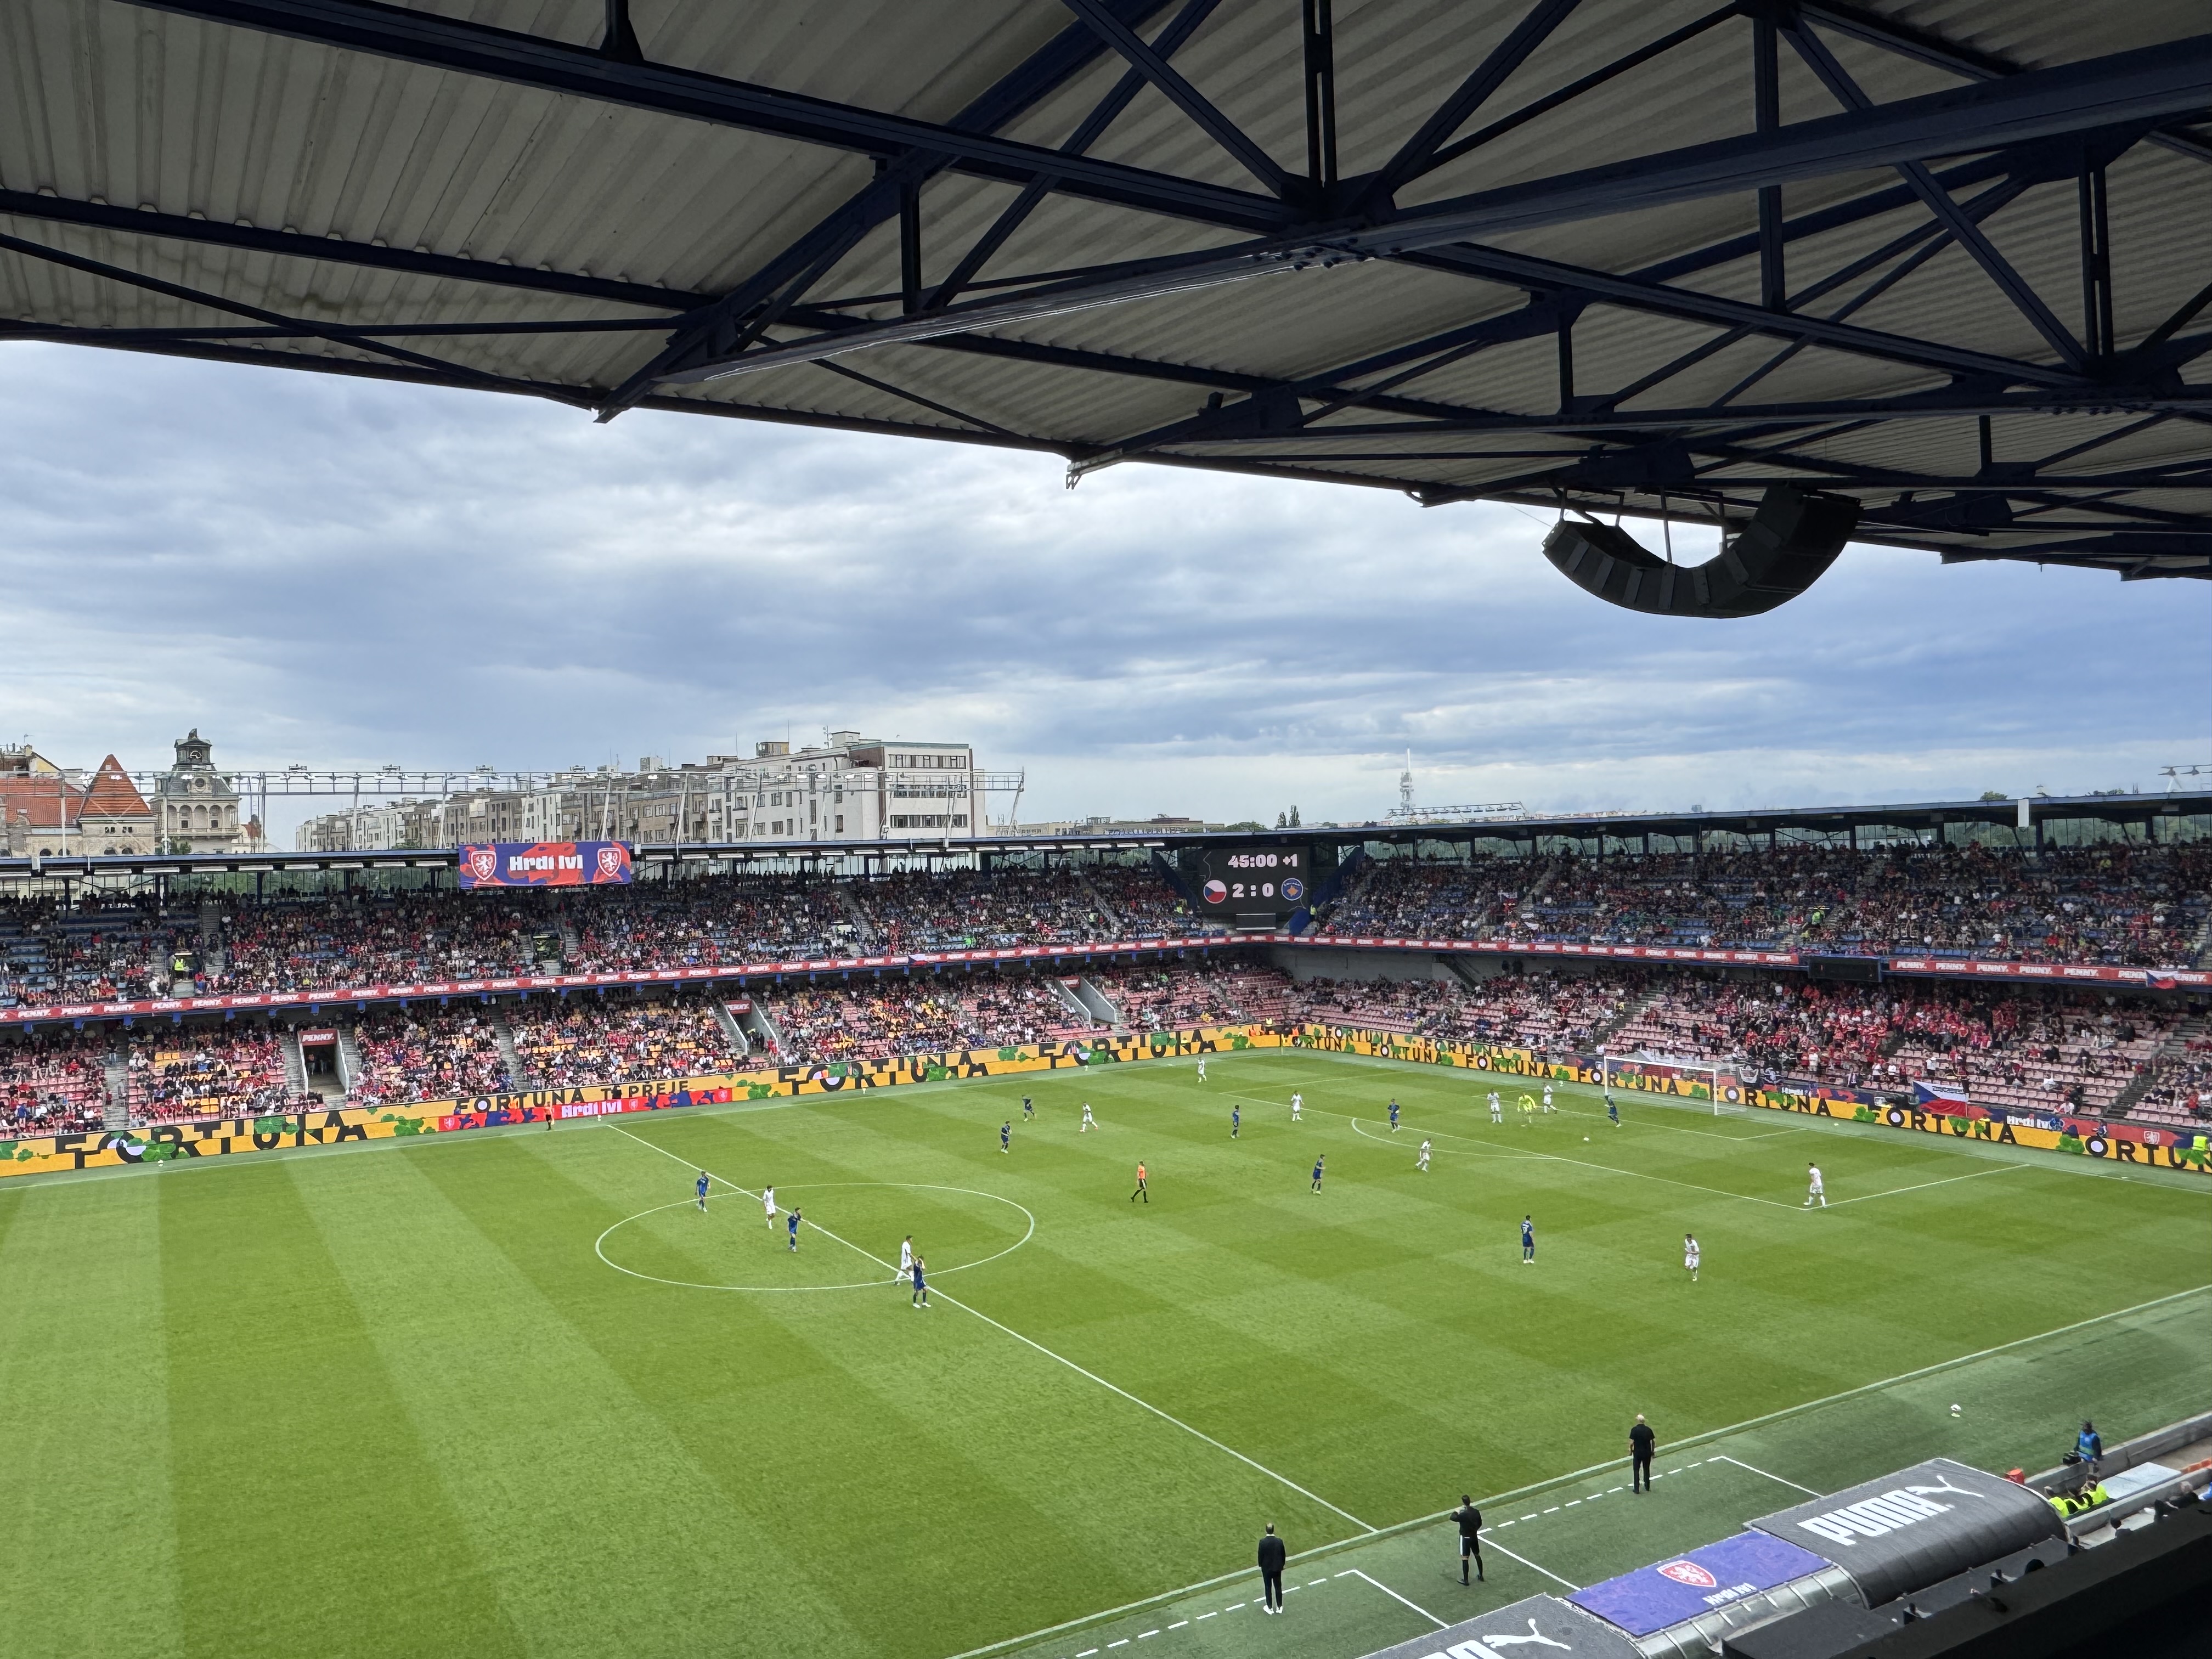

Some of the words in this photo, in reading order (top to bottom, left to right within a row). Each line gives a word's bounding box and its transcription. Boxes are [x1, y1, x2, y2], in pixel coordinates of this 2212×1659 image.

[1228, 854, 1278, 868] 45:00
[1282, 853, 1298, 867] +1
[1232, 883, 1245, 898] 2
[1262, 882, 1274, 898] 0
[778, 1051, 989, 1095] FORTUNA
[456, 1087, 585, 1113] FORTUNA
[55, 1110, 368, 1169] FORTUNA
[1797, 1489, 1950, 1546] PUMA
